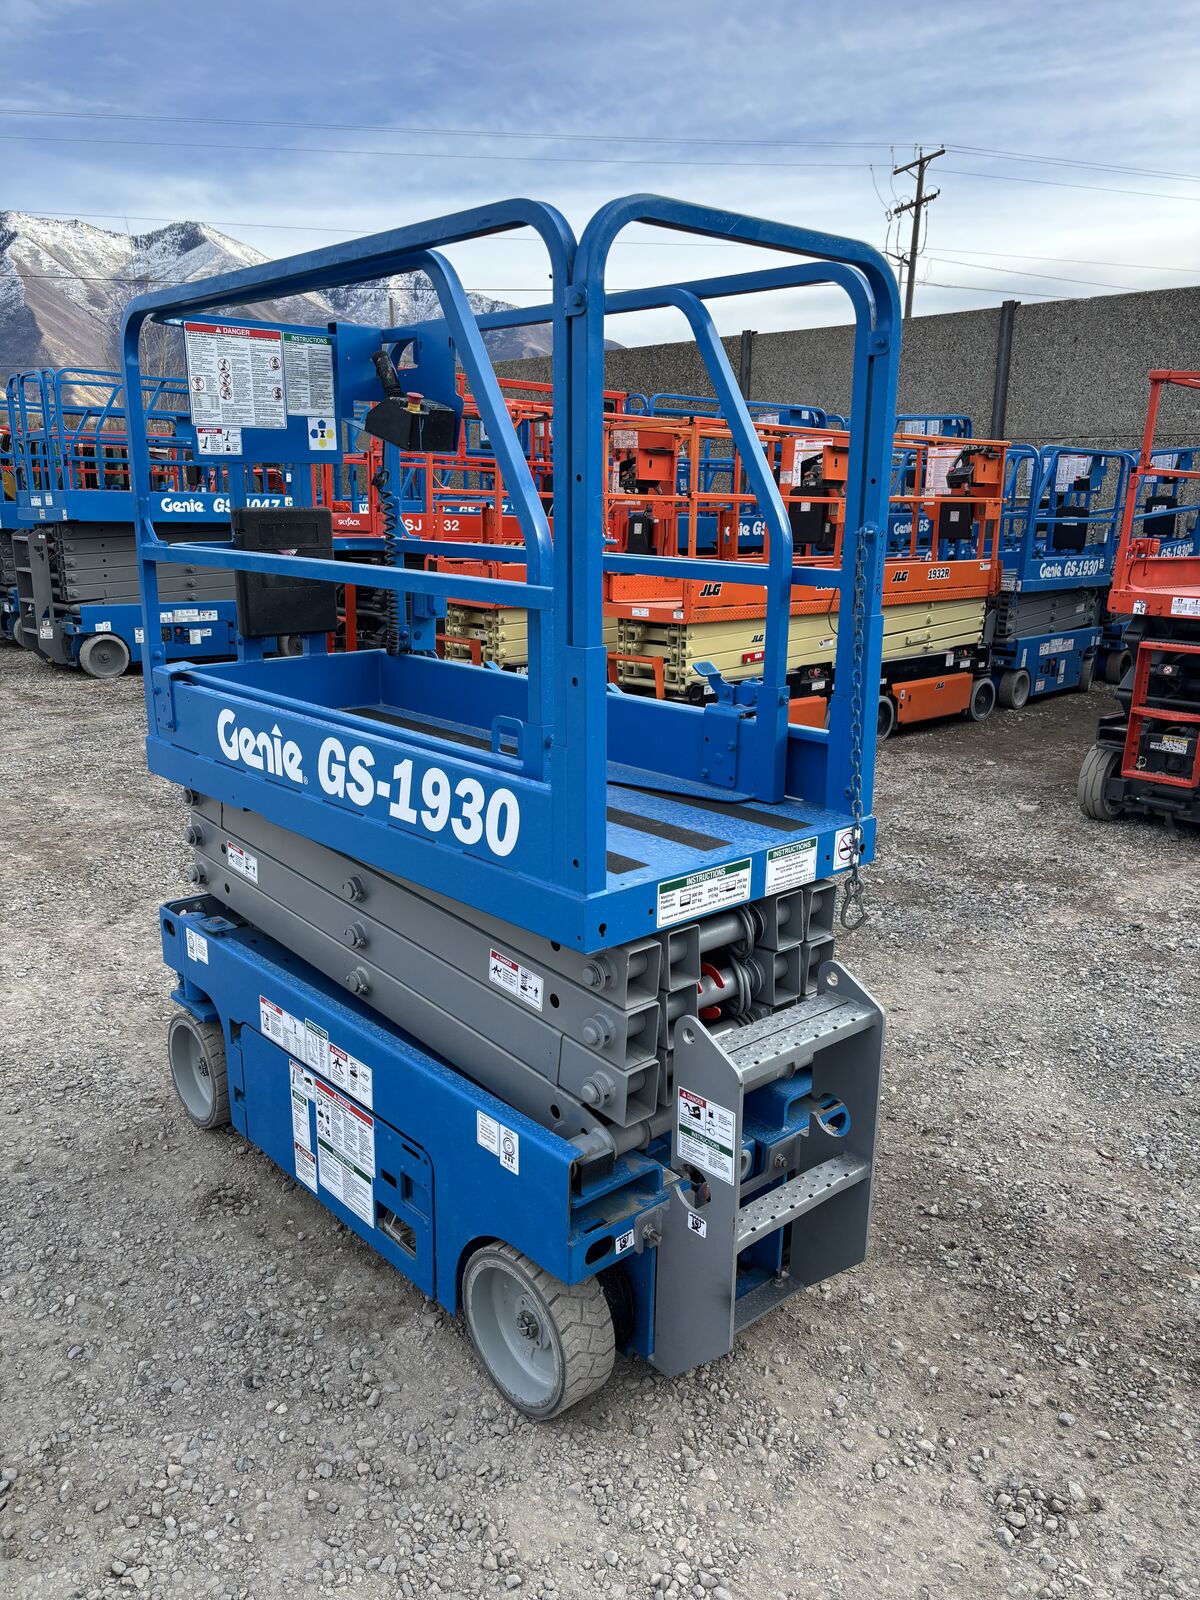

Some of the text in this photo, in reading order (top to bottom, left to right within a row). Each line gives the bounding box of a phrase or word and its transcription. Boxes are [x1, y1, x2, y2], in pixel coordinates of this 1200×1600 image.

[223, 327, 250, 336] DANGER
[291, 335, 327, 344] INSTRUCTIONS
[161, 498, 204, 512] Genie
[338, 516, 360, 526] SKYJACK
[892, 568, 950, 582] JLG 1932R
[1040, 560, 1098, 578] Genie GS-1930
[700, 584, 721, 596] JLG
[752, 634, 764, 643] JLG
[217, 708, 520, 857] Genie GS-1930
[773, 841, 811, 858] INSTRUCTIONS
[687, 868, 726, 885] INSTRUCTIONS
[686, 1093, 704, 1106] DANGER
